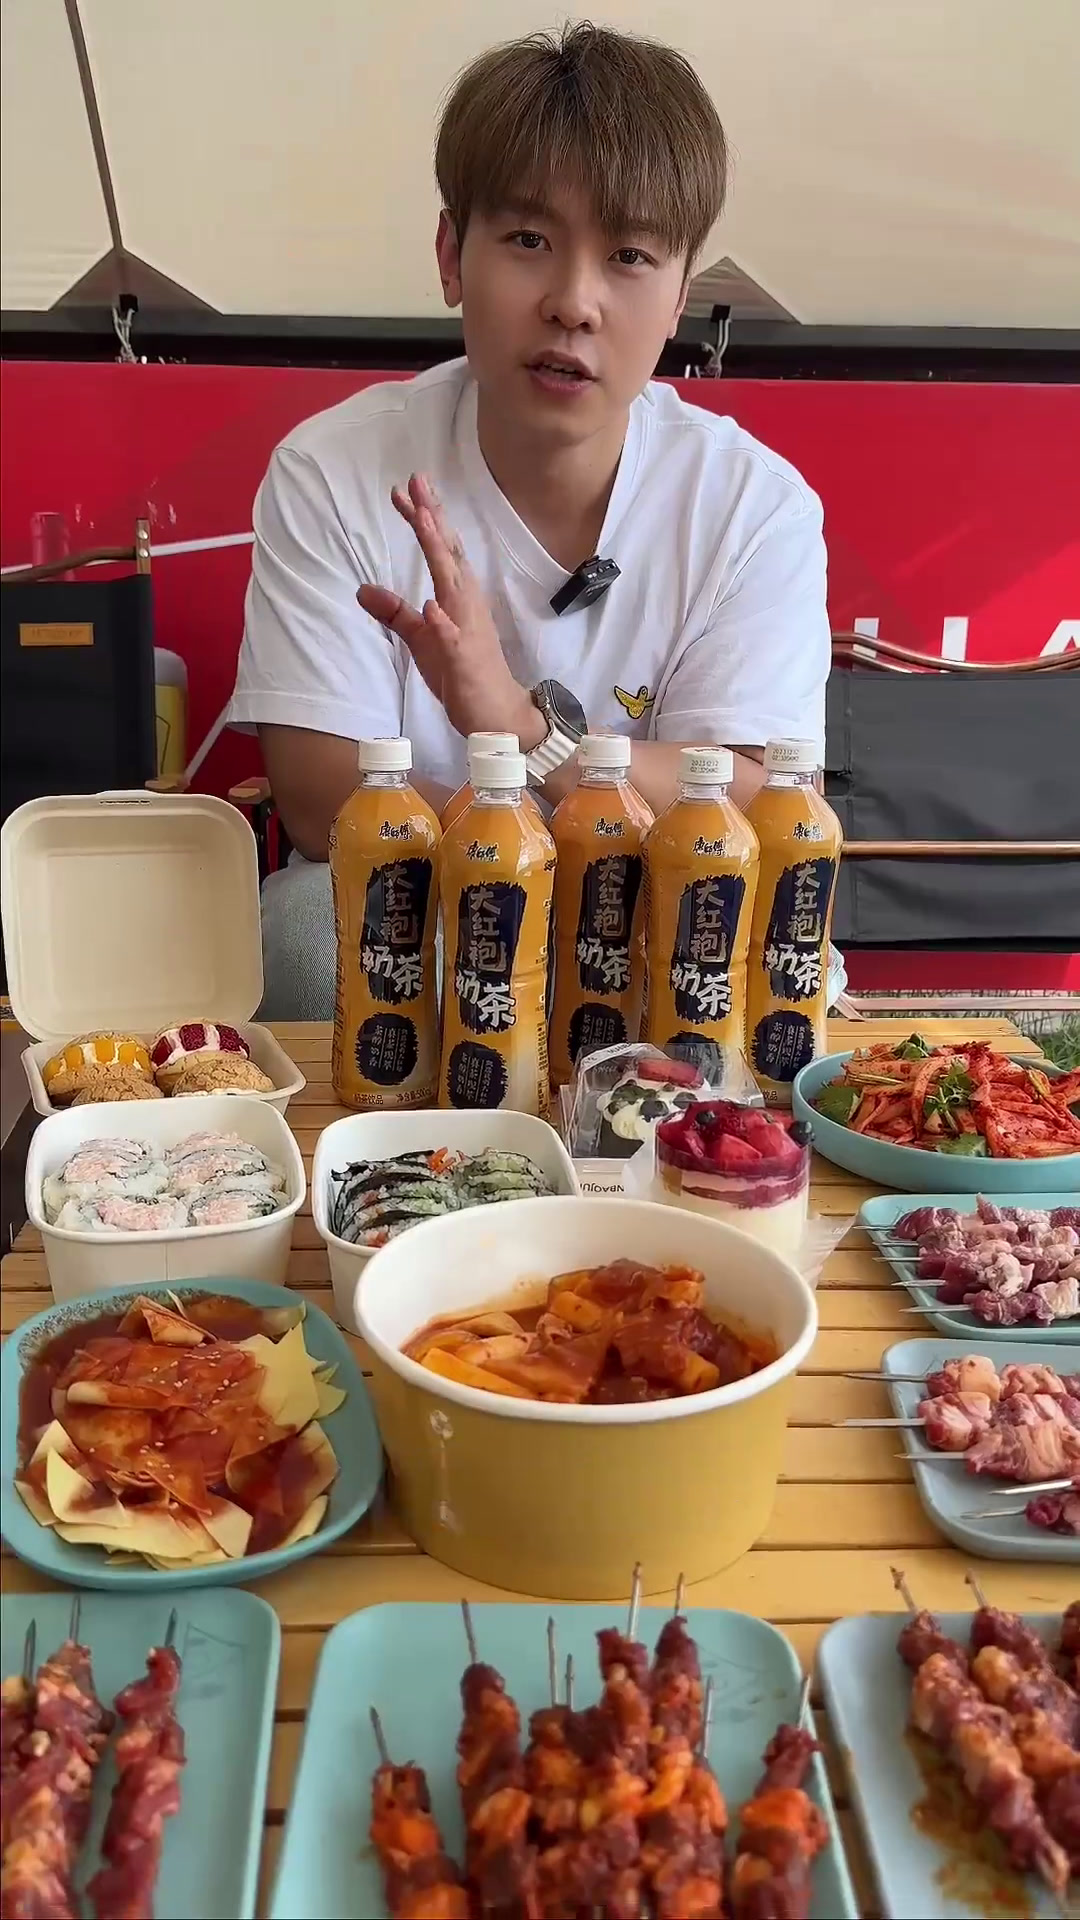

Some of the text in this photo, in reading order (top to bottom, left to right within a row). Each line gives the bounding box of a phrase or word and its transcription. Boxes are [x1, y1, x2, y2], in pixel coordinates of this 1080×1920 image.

[381, 865, 418, 945] 大红袍
[468, 886, 507, 973] 大红袍
[593, 857, 626, 938] 大红袍
[690, 880, 726, 962] 大红袍
[788, 863, 821, 942] 大红袍
[361, 946, 423, 996] 奶茶
[576, 940, 632, 989] 奶茶
[671, 963, 732, 1017] 奶茶
[764, 943, 822, 995] 奶茶
[455, 970, 517, 1029] 奶茶
